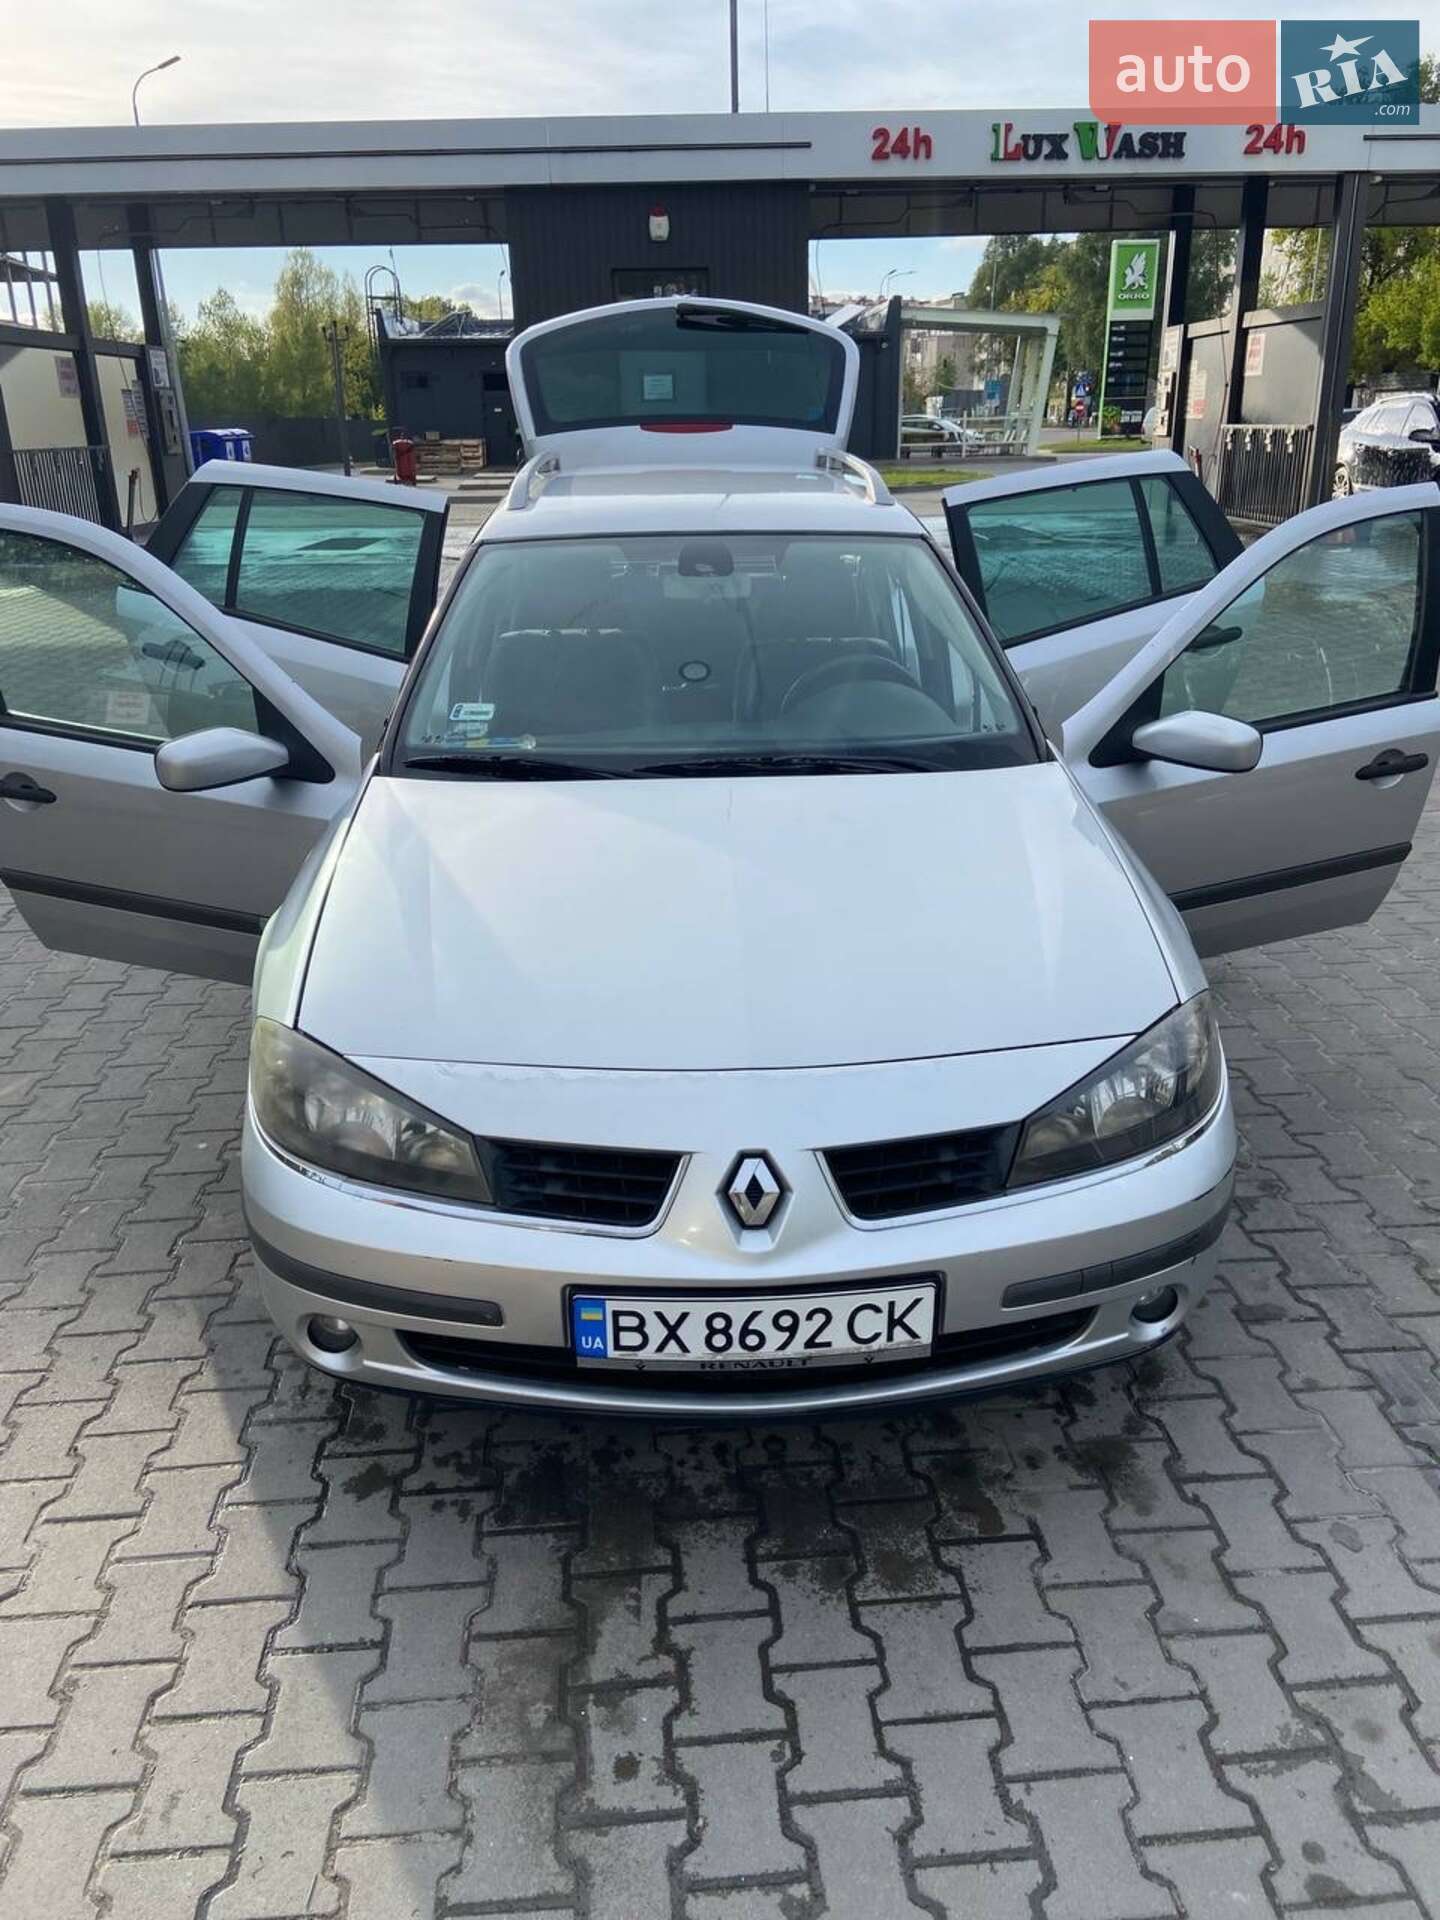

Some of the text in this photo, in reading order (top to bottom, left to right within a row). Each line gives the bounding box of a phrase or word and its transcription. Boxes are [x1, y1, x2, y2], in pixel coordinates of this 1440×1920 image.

[871, 127, 932, 160] 24h
[1243, 123, 1306, 155] 24h
[611, 1297, 925, 1354] BX 8692 CK
[580, 1336, 604, 1350] UA
